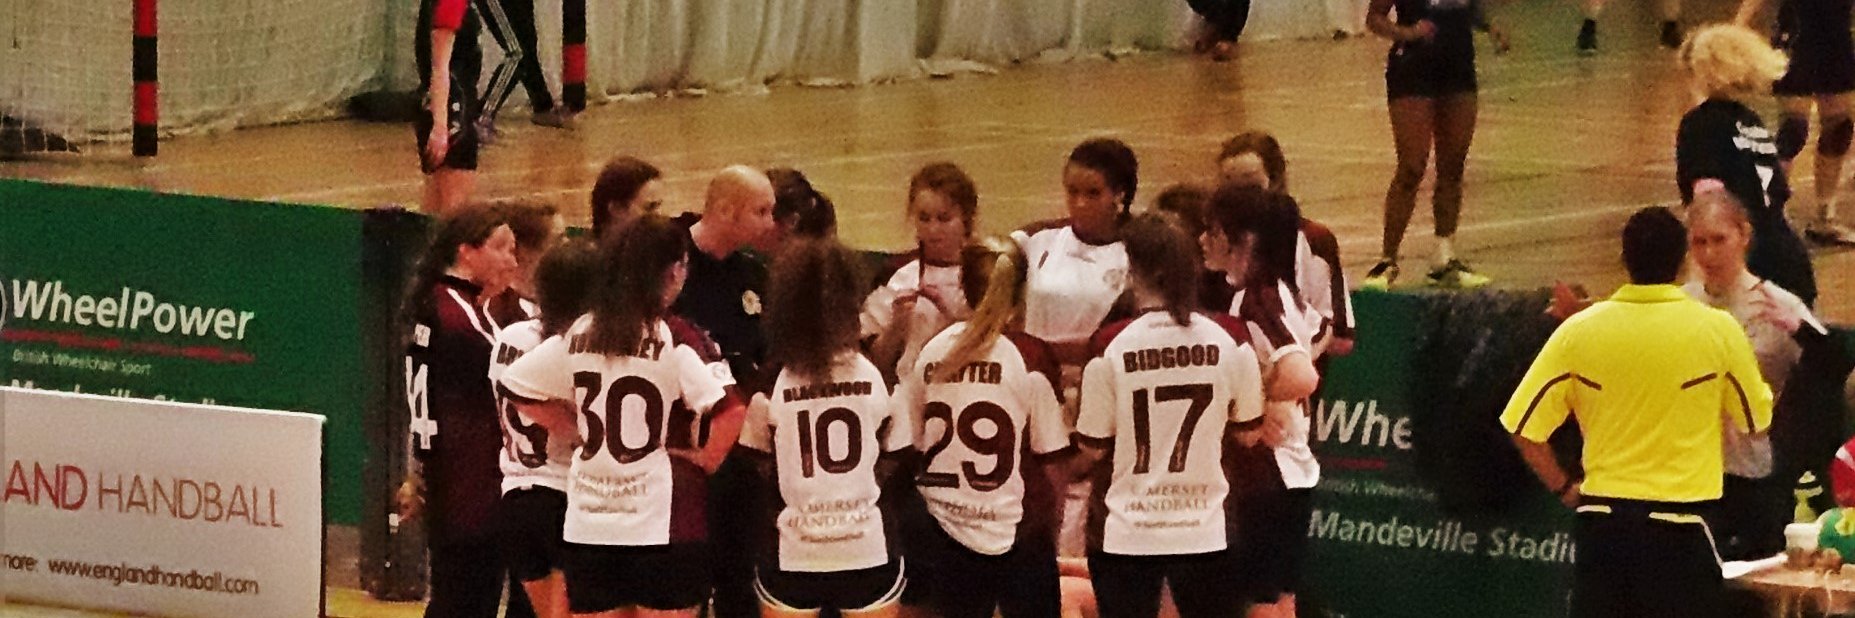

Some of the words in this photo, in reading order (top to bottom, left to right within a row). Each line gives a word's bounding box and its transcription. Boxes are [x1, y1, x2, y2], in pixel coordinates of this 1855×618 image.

[13, 279, 255, 341] WheelPower
[1123, 344, 1220, 373] BIDGOOD
[573, 370, 663, 464] 30
[797, 406, 862, 478] 10
[916, 401, 1016, 492] 29
[1132, 382, 1214, 475] 17
[1, 459, 88, 511] AND
[97, 472, 284, 528] HANDBALL
[1307, 508, 1478, 555] Mandeville
[48, 557, 259, 594] www.englandhandball.com
